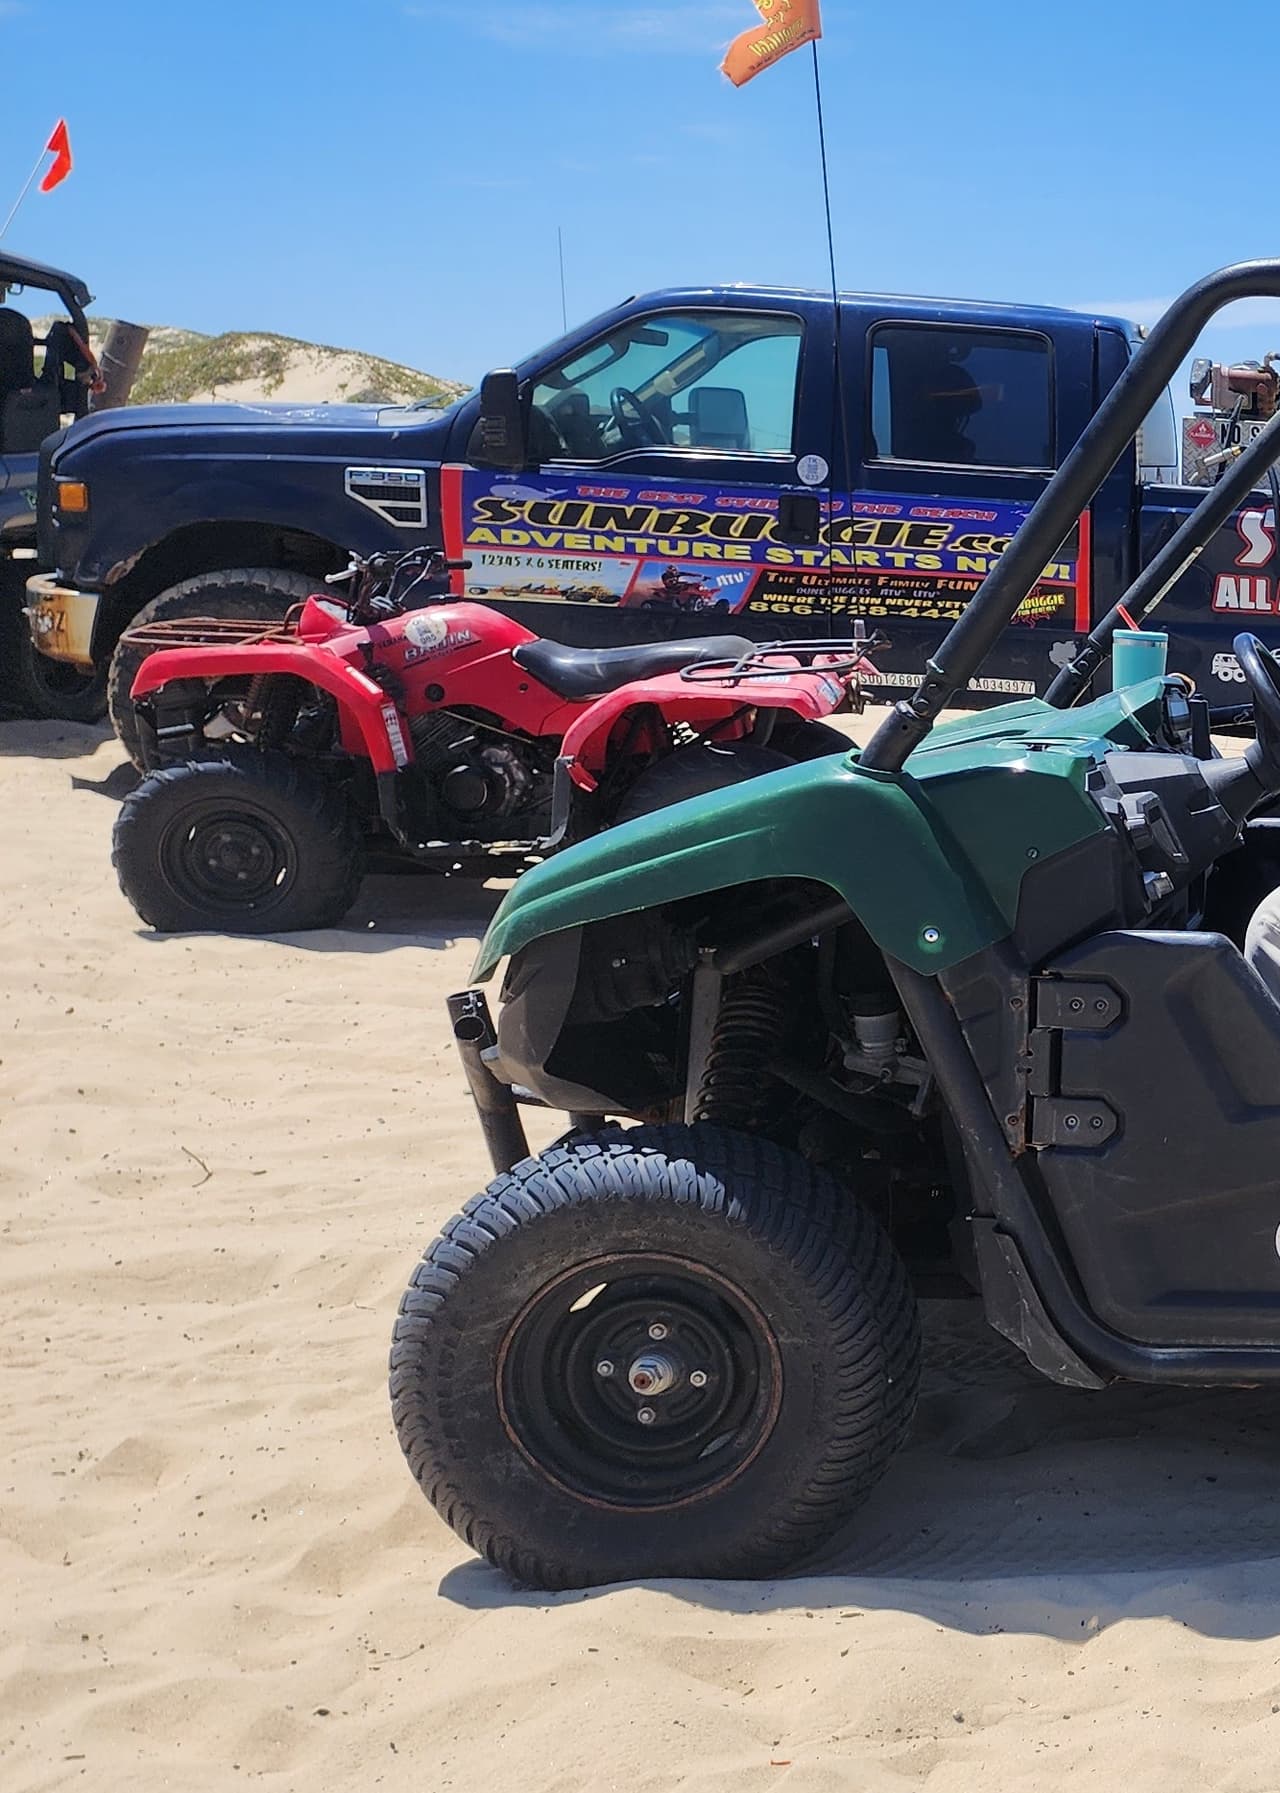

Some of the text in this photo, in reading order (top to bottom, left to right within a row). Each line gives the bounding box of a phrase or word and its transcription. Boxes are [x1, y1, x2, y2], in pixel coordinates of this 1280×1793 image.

[575, 485, 631, 499] THE
[852, 502, 903, 515] THE
[466, 527, 752, 562] ADVENTURE
[766, 547, 943, 570] STARTS
[762, 593, 817, 604] WHERE
[885, 597, 933, 608] NEVER
[1214, 576, 1272, 611] ALL
[748, 601, 961, 620] 866-728-444
